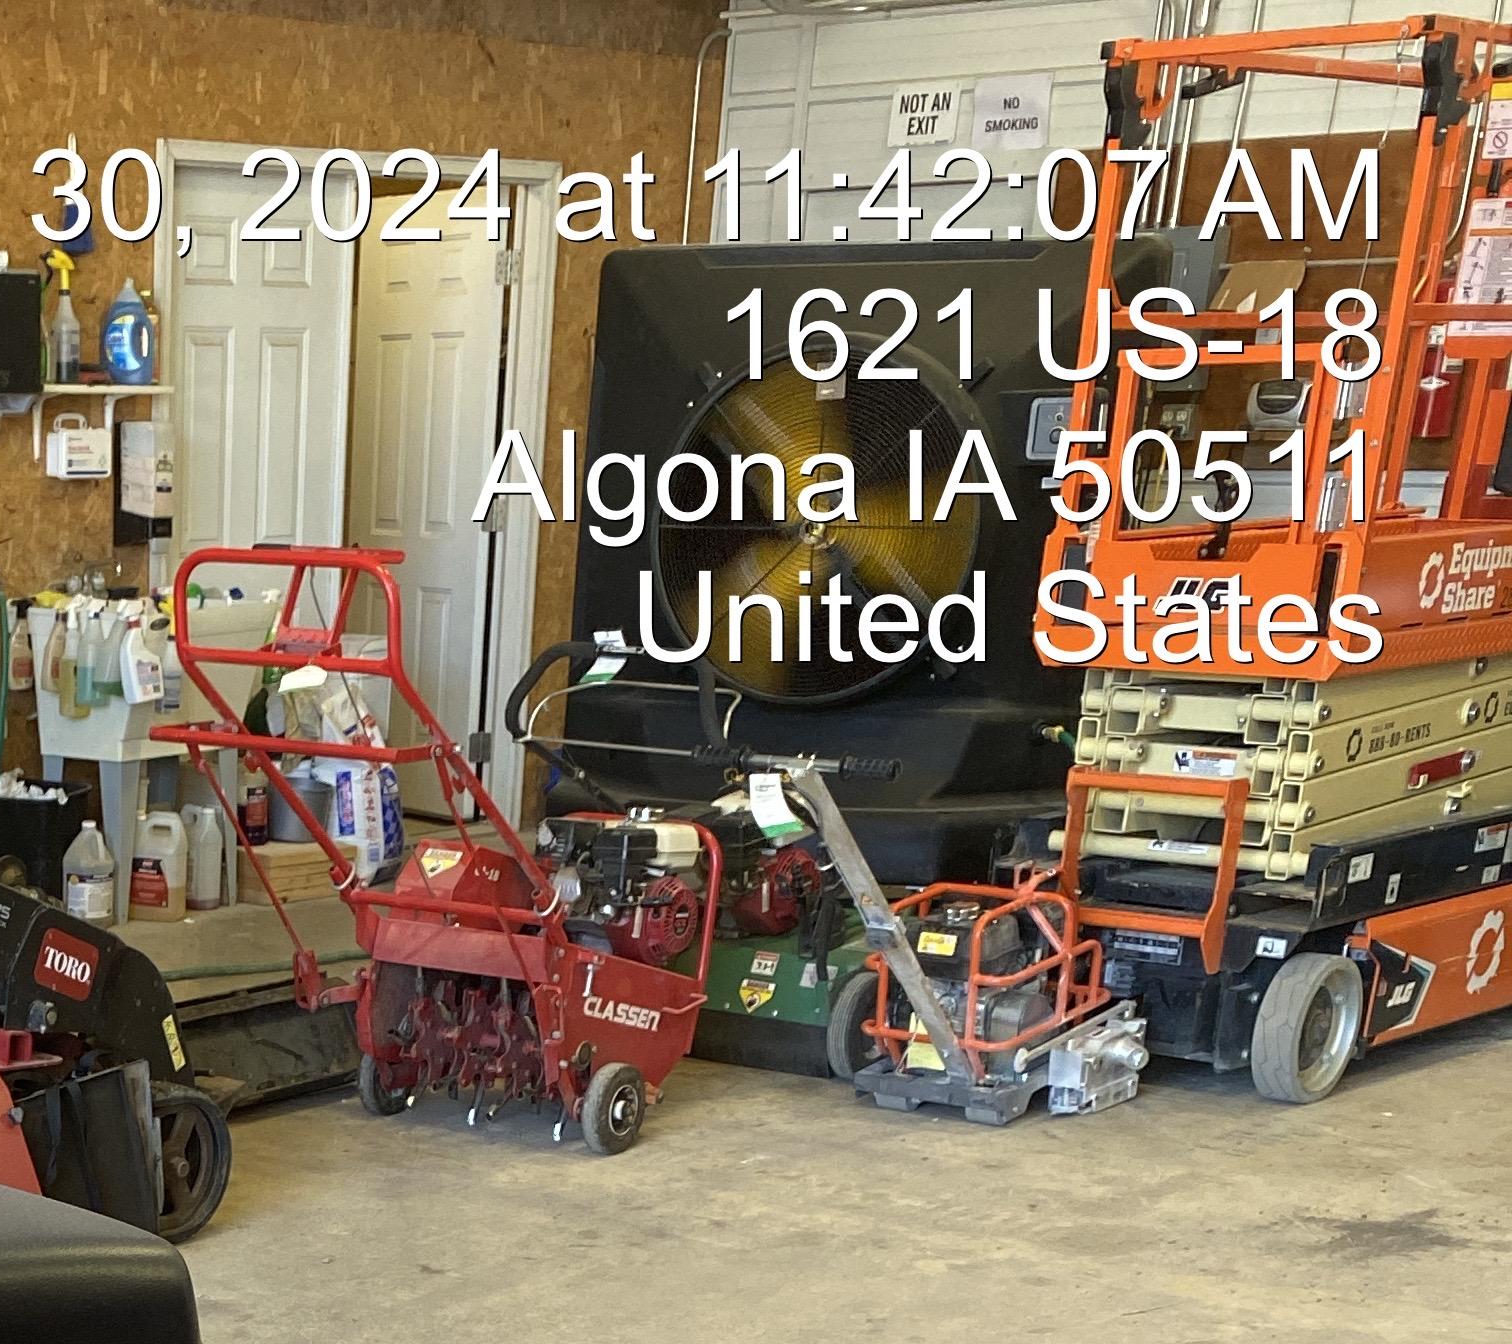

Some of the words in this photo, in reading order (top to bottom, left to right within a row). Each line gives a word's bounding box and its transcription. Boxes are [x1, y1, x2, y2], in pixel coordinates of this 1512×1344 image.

[900, 94, 929, 114] NOT
[931, 92, 952, 111] AN
[1003, 97, 1020, 110] NO
[907, 115, 939, 136] EXIT
[984, 117, 1039, 132] SMOKING
[1441, 581, 1497, 615] Share
[44, 945, 92, 983] TORO
[583, 995, 661, 1032] CLASSEN
